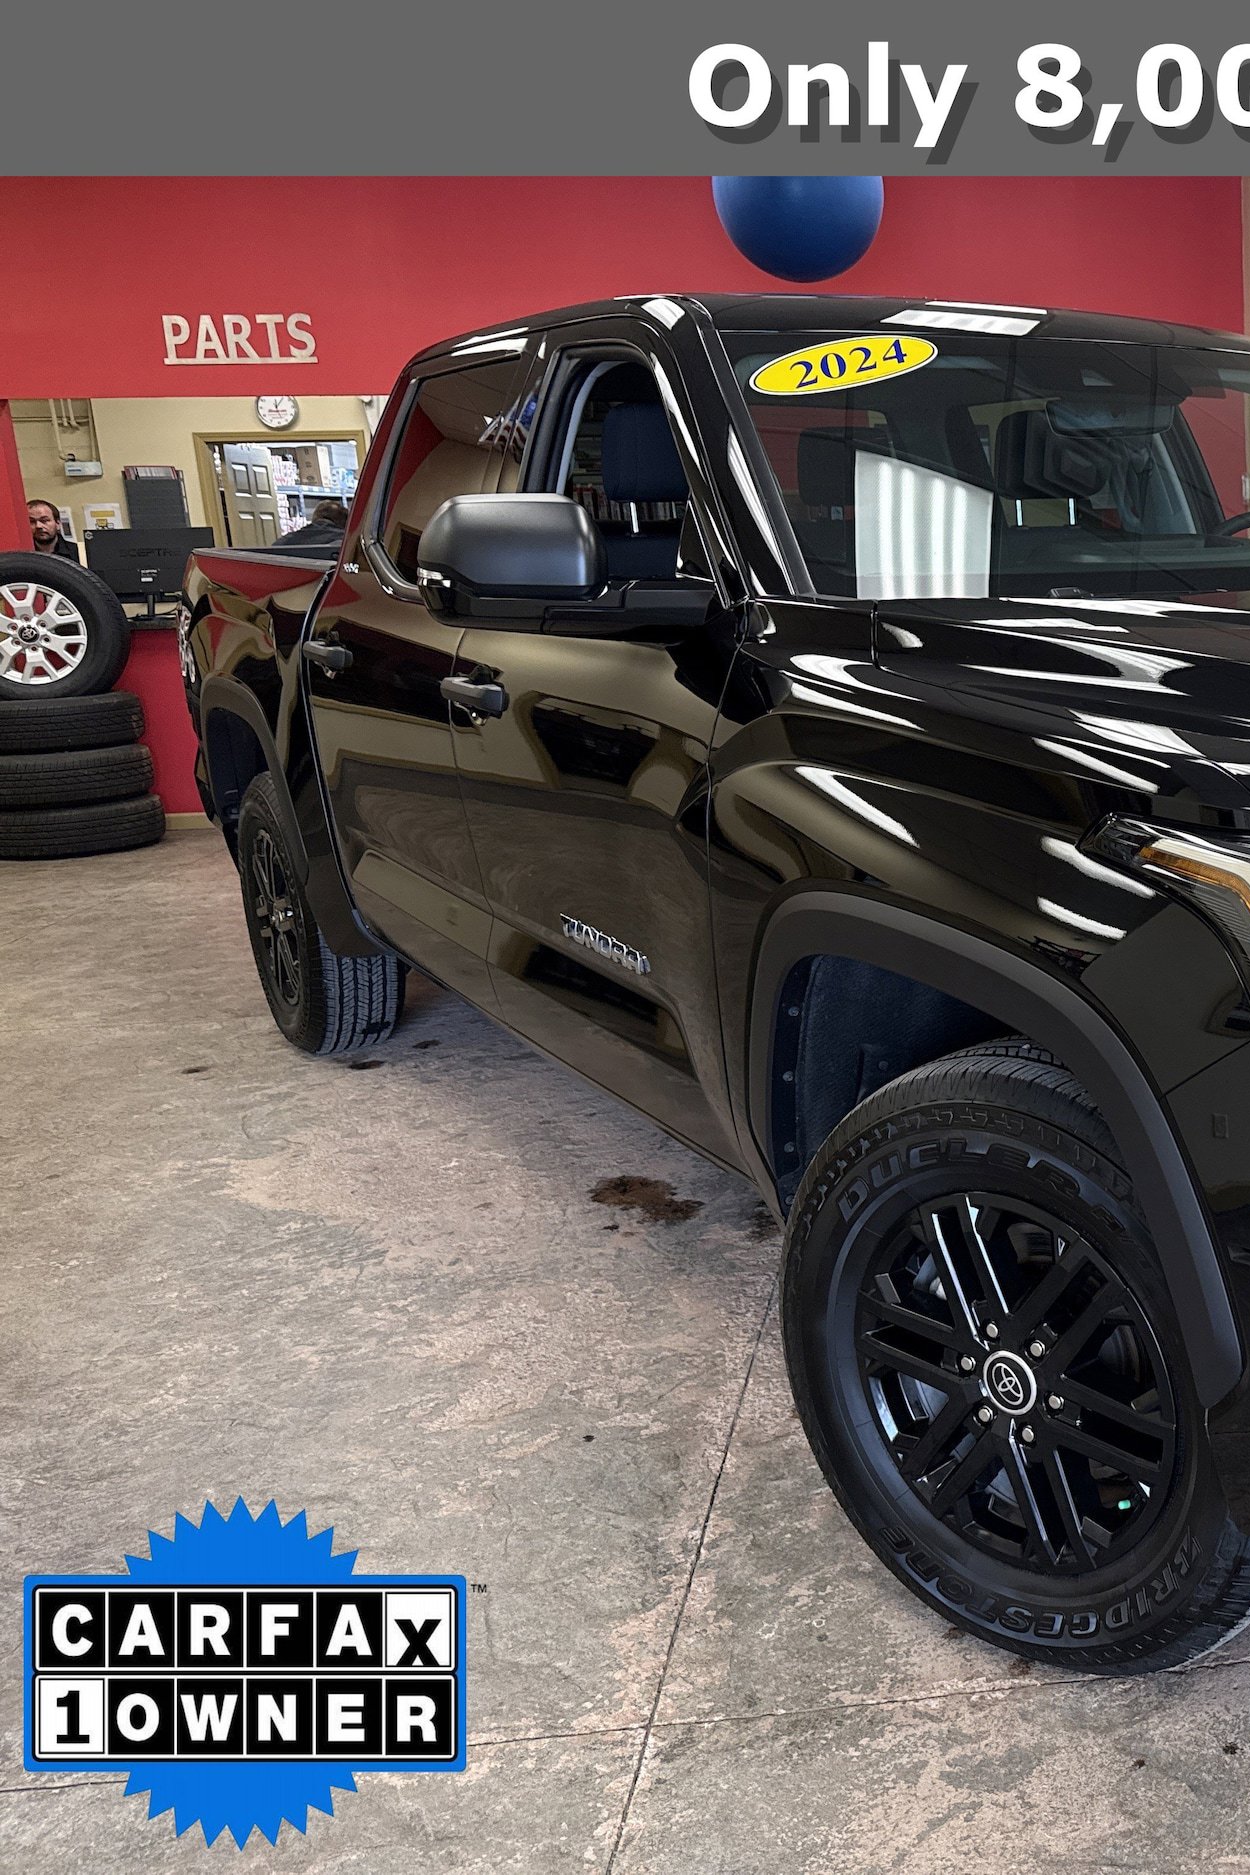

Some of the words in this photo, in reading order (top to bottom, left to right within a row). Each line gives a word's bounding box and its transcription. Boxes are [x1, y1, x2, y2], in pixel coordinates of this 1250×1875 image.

[162, 313, 317, 365] PARTS
[790, 339, 907, 388] 2024
[560, 913, 651, 976] TUNDRA
[879, 1525, 1203, 1640] BRIDGESTONE
